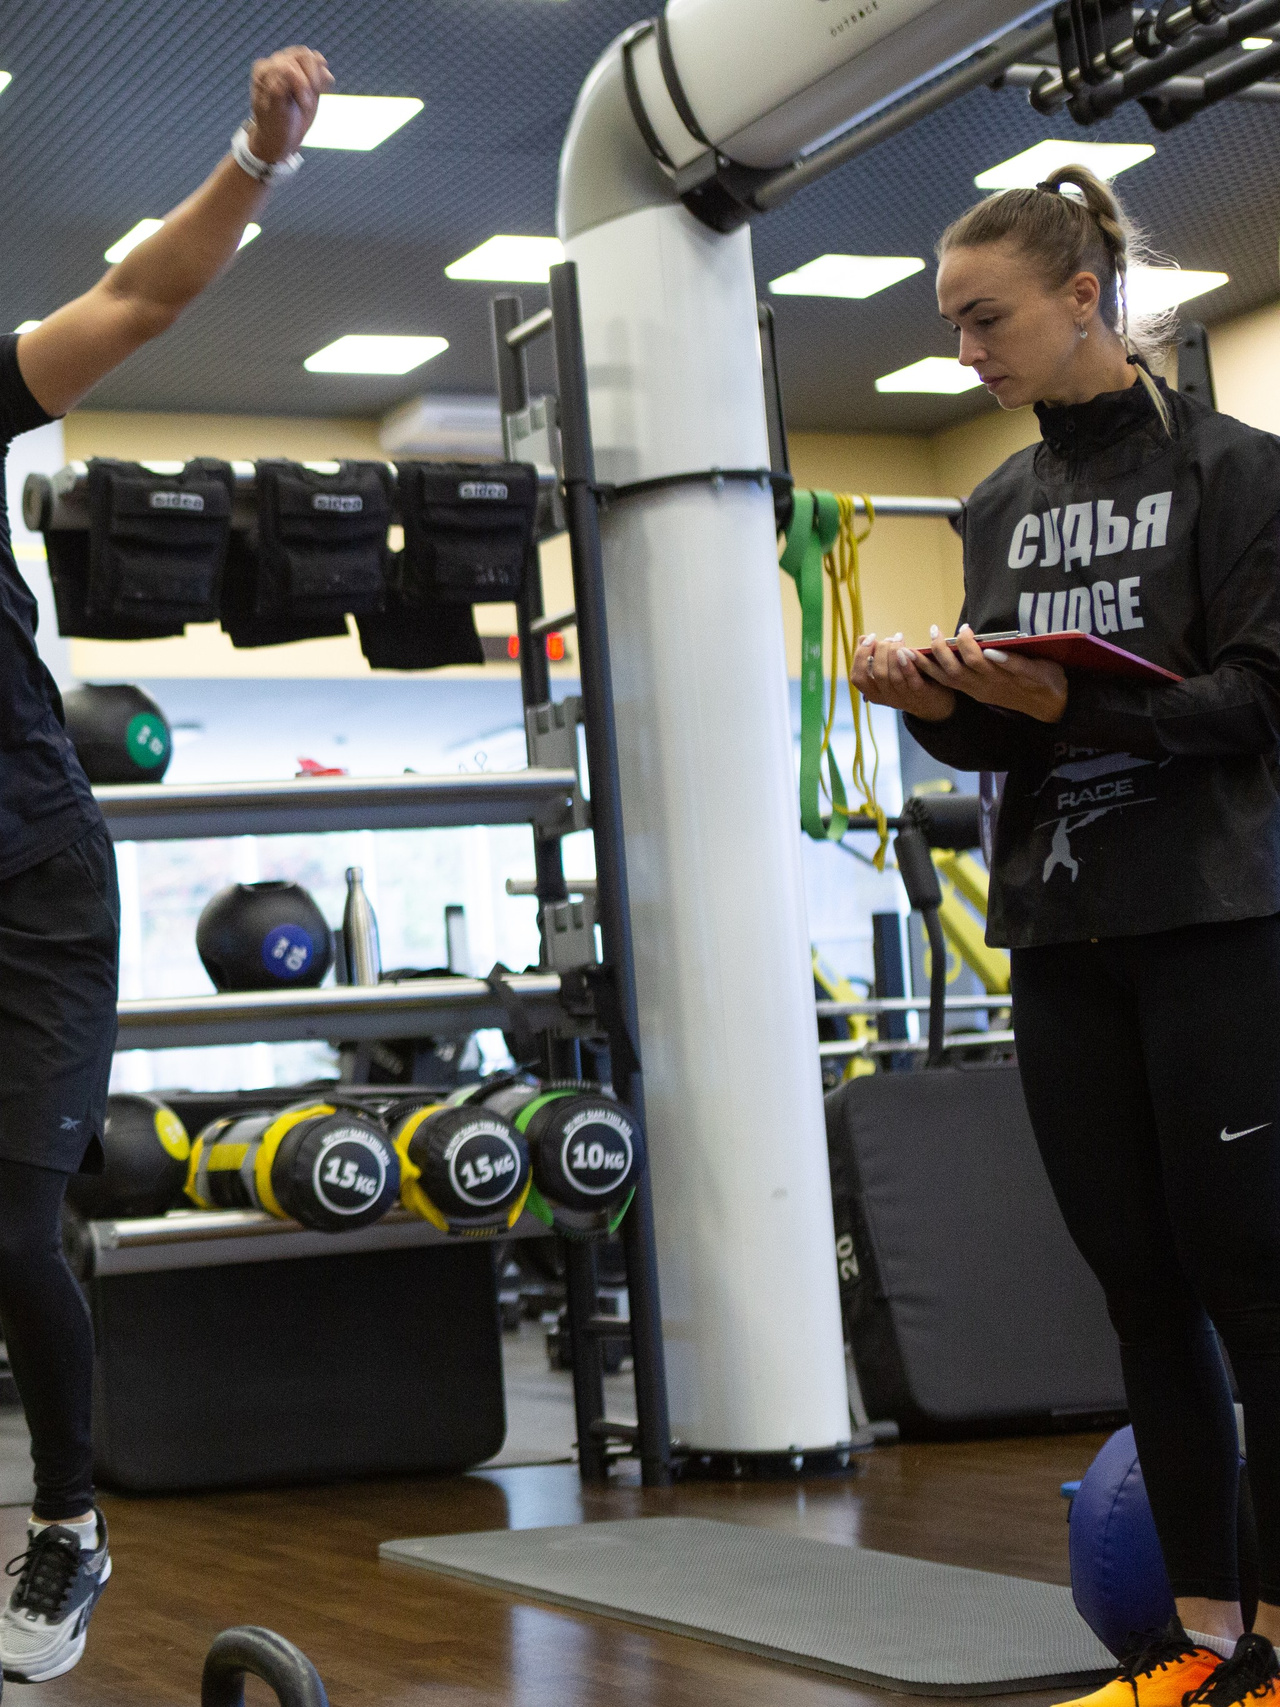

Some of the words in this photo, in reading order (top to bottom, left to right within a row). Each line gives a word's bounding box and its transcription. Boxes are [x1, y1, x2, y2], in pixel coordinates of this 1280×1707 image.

[1007, 491, 1173, 573] СУДЬЯ
[1057, 778, 1135, 811] RACE
[285, 944, 308, 971] 10
[836, 1233, 859, 1281] 20
